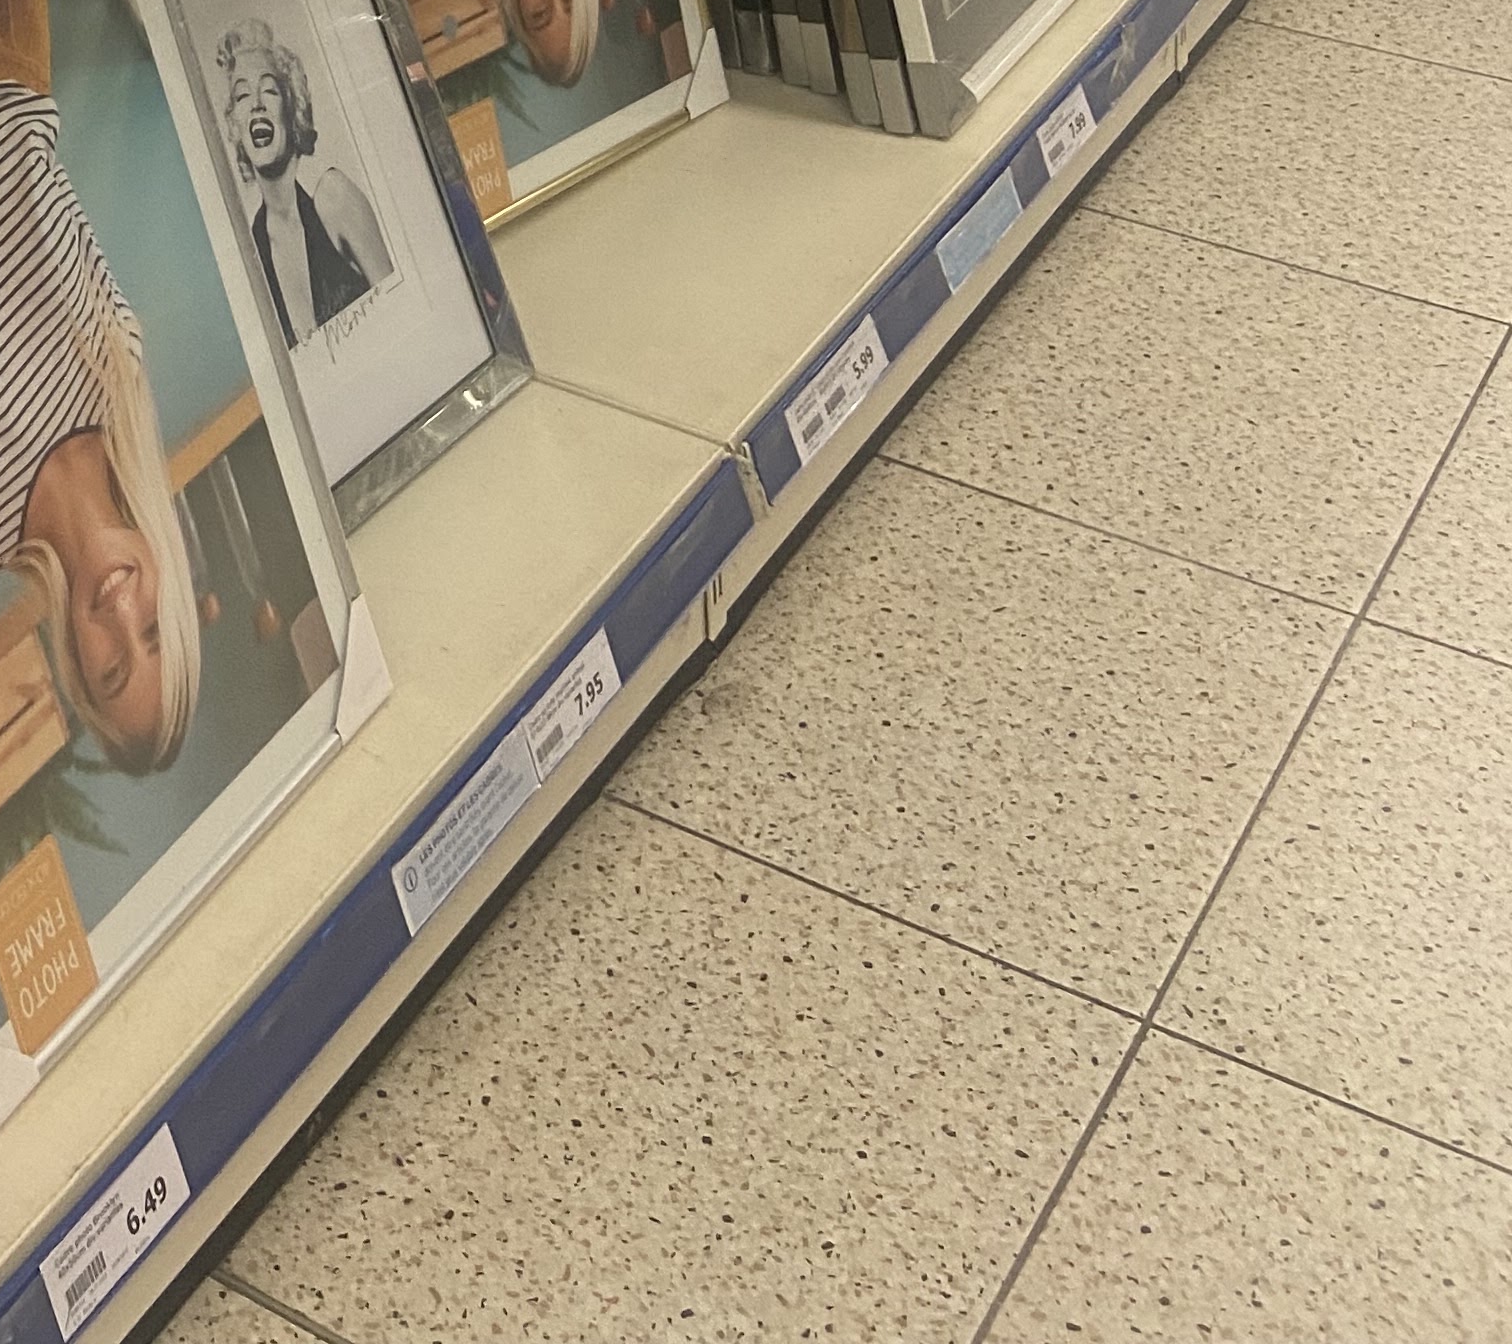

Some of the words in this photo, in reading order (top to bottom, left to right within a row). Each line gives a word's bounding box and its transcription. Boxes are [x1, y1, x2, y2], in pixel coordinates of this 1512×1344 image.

[852, 345, 874, 379] 5.99
[574, 671, 604, 716] 7.95
[4, 897, 67, 978] FRAME
[19, 939, 81, 1019] PHOTO
[54, 1242, 74, 1269] Cadre
[75, 1223, 93, 1247] photo
[93, 1192, 120, 1225] Brooklyn
[126, 1176, 167, 1235] 6.49
